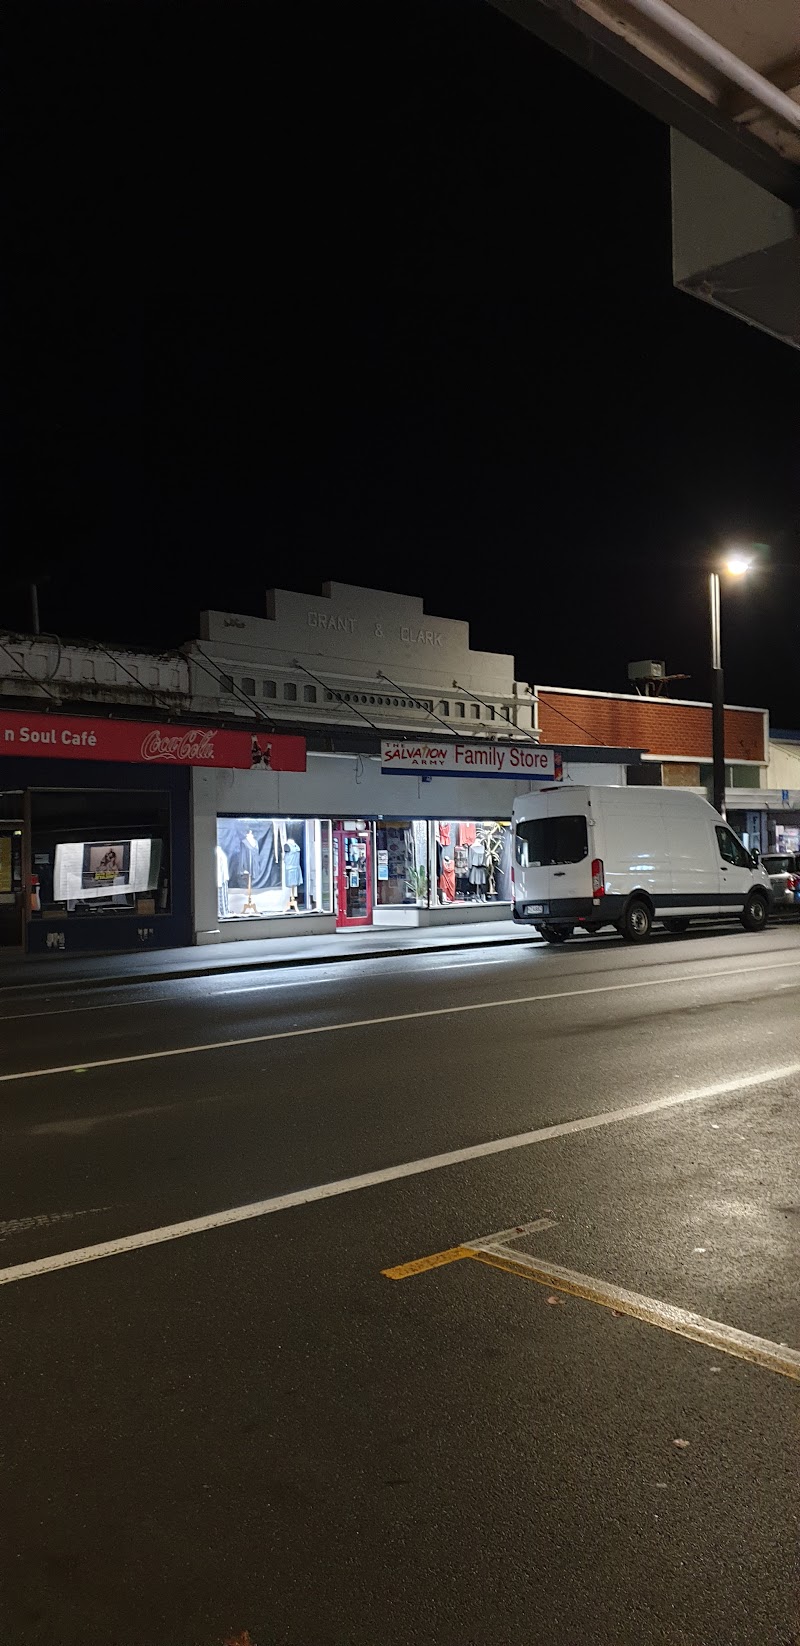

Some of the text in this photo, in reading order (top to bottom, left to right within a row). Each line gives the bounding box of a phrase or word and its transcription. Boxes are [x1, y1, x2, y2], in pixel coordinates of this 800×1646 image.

[307, 611, 443, 647] GRANT & CLARK
[19, 727, 57, 744] Soul
[61, 729, 98, 747] Café
[384, 744, 448, 762] SALVATION
[454, 744, 505, 771] Family
[509, 747, 549, 769] Store
